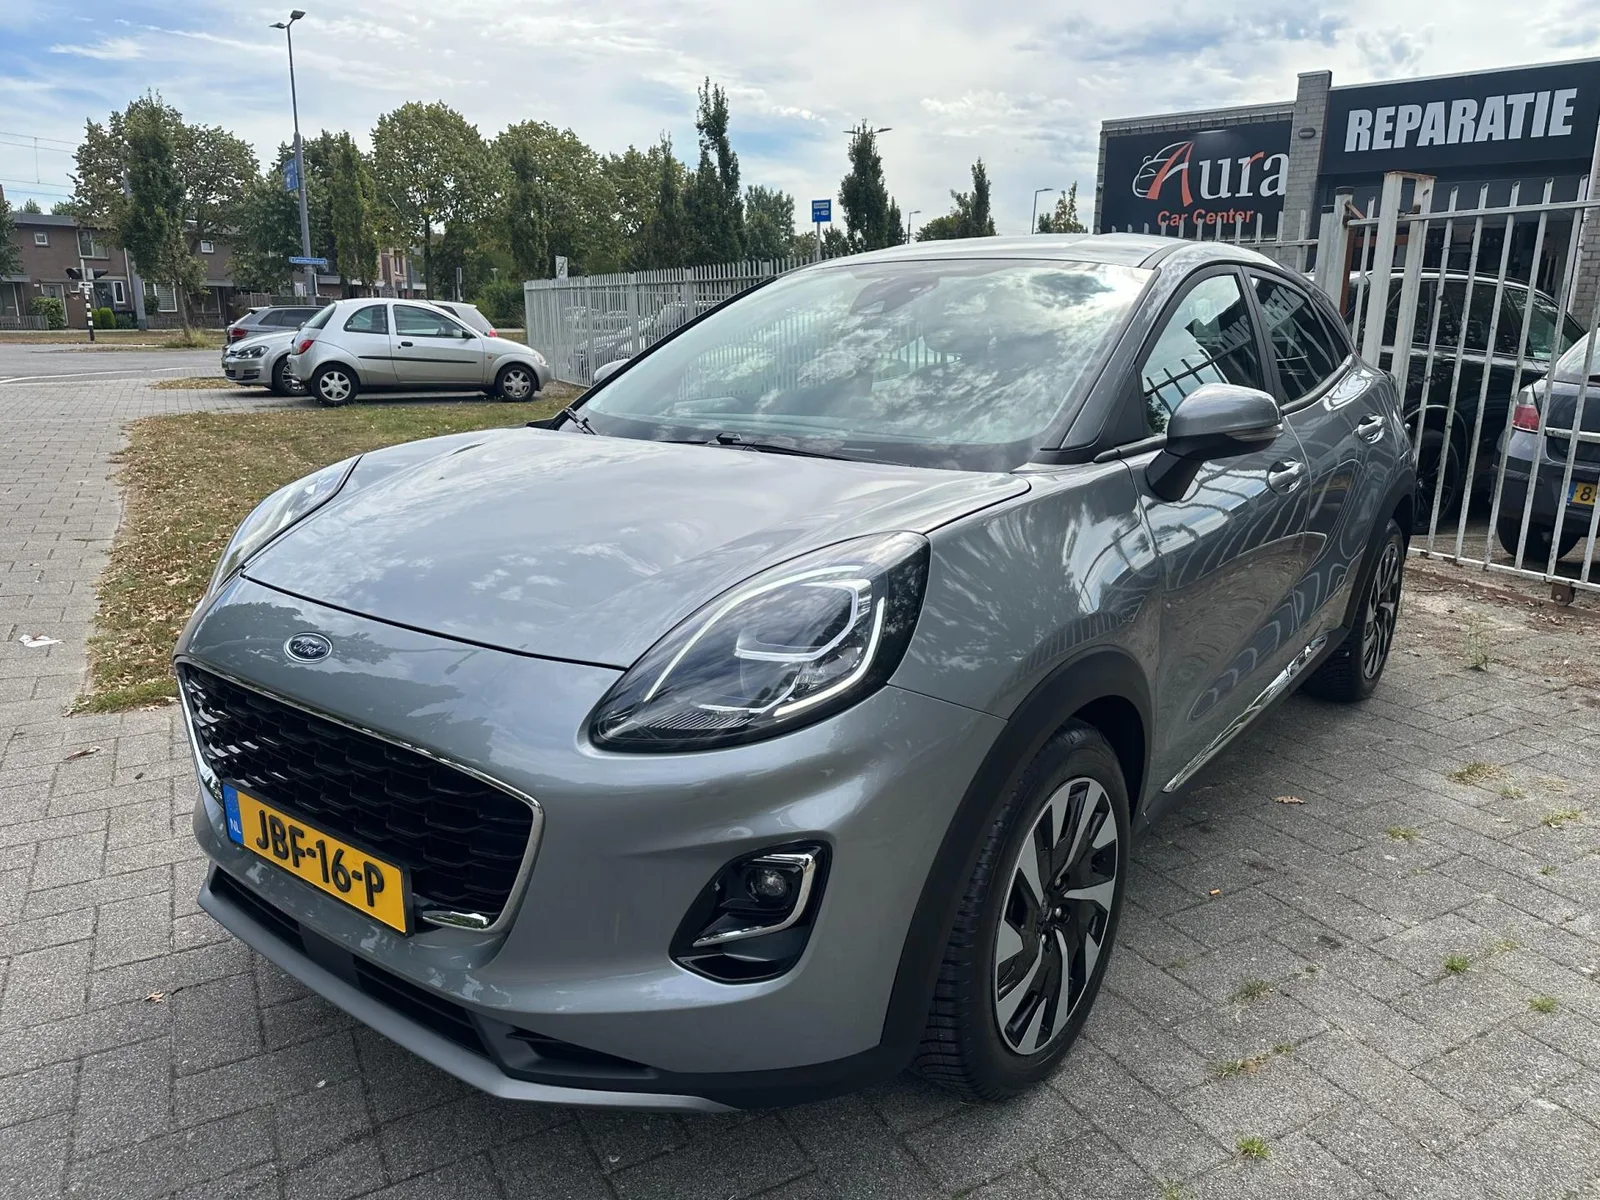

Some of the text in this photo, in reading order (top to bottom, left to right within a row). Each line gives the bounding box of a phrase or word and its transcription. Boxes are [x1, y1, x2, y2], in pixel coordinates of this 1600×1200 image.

[1344, 88, 1578, 153] REPARATIE
[1144, 140, 1290, 207] Aura
[1157, 207, 1255, 227] Car Center
[1580, 486, 1596, 502] 8
[292, 636, 323, 656] Ford
[229, 809, 385, 908] NL JBF-16-P
